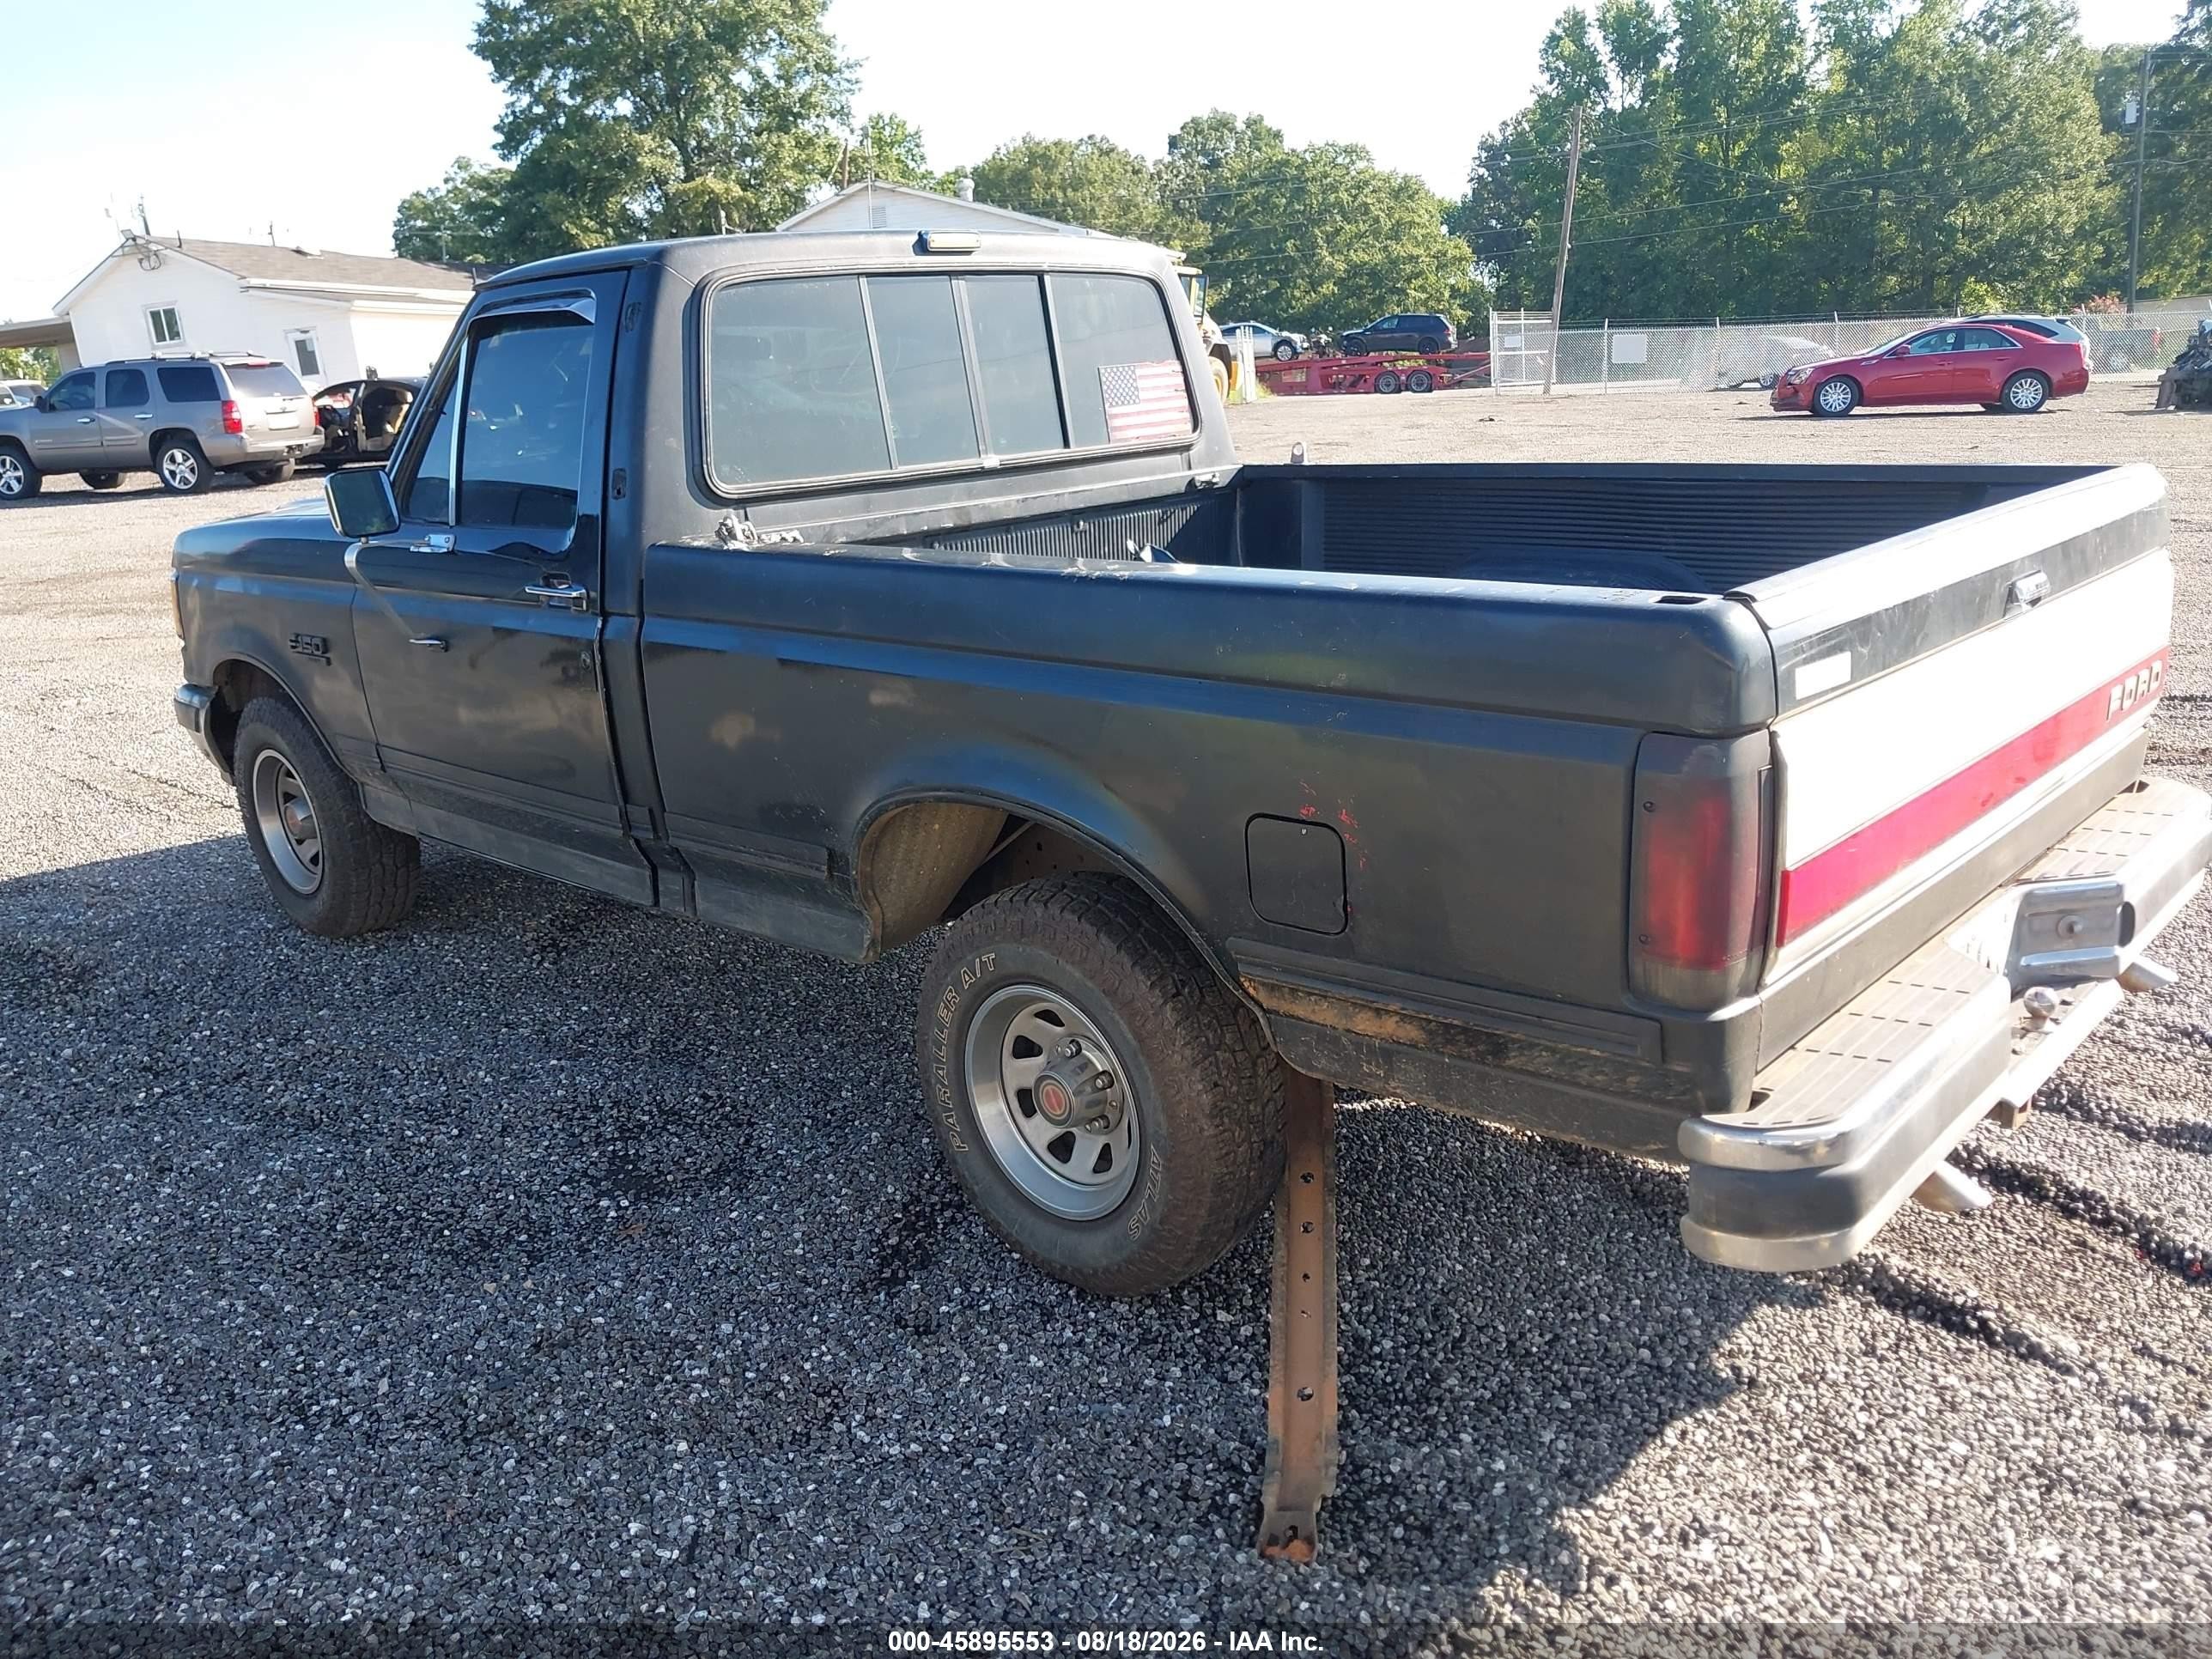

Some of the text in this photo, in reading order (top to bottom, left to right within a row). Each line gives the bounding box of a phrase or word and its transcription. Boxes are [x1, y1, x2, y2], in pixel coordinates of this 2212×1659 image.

[2106, 659, 2163, 720] FORD
[933, 952, 996, 1152] PARALLER A/T
[1127, 1142, 1162, 1240] ATLAS
